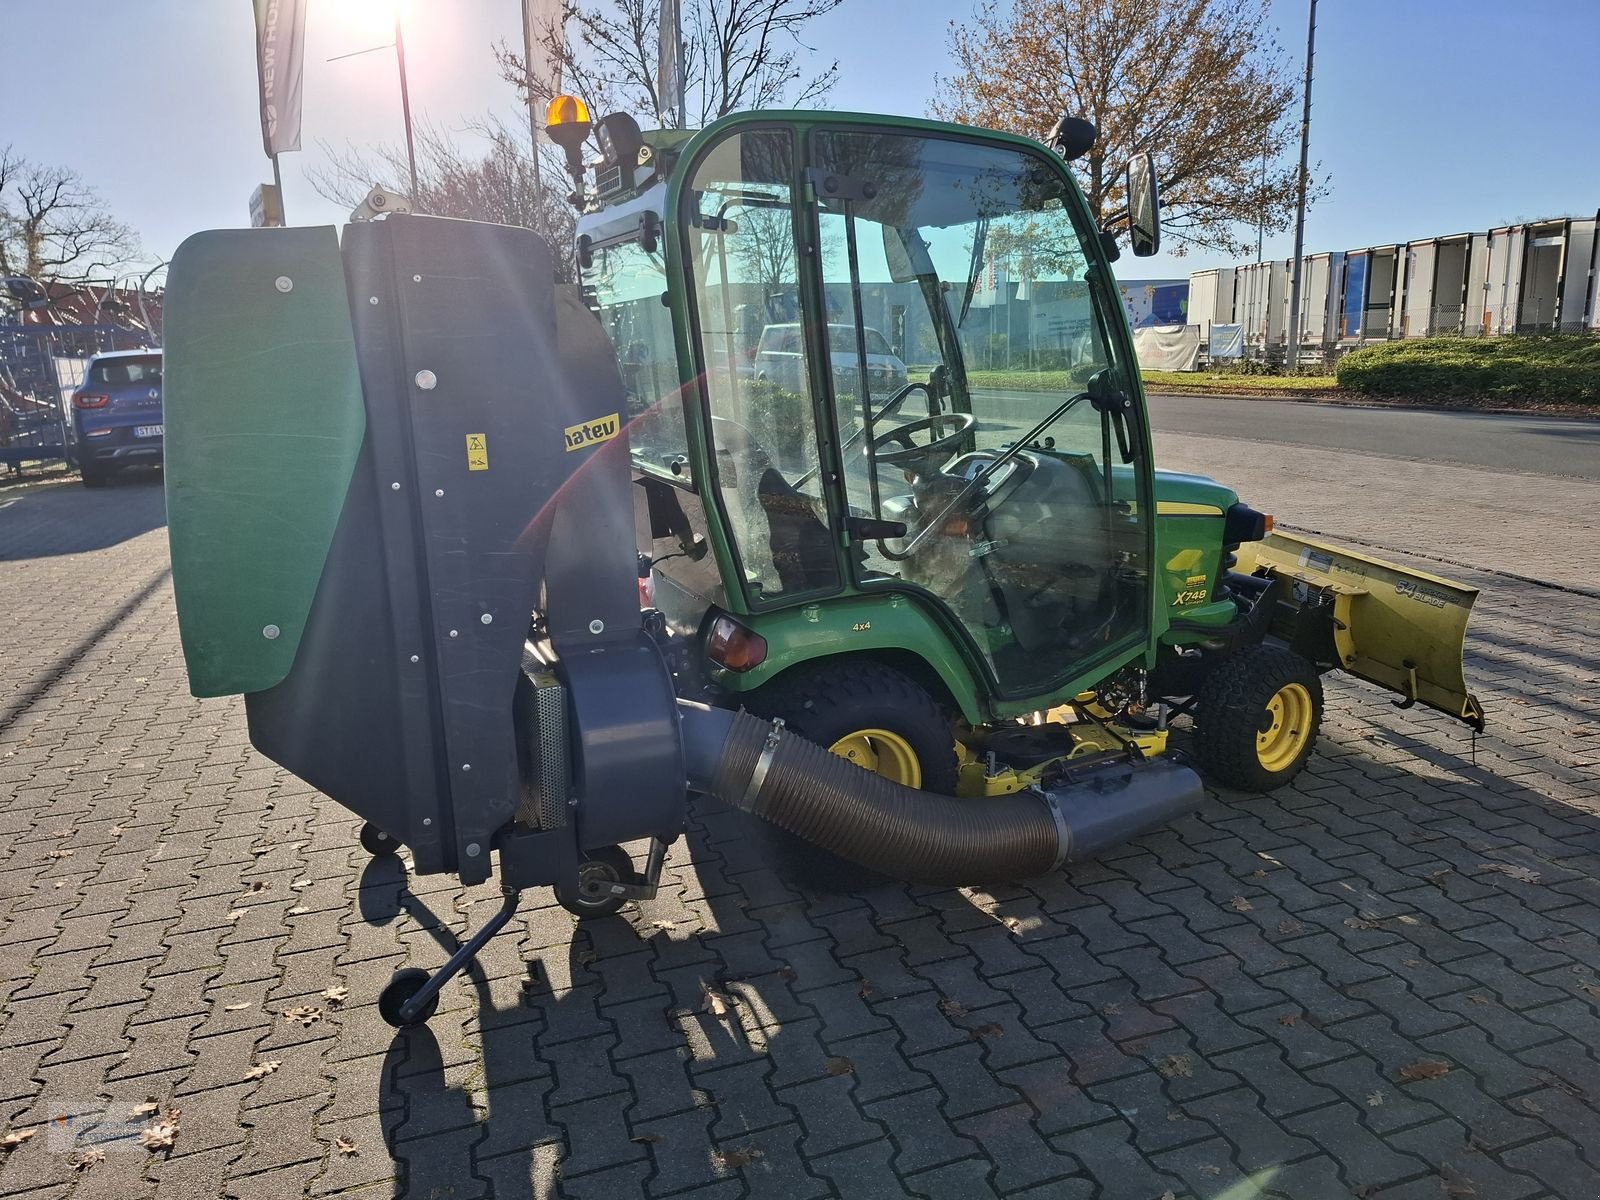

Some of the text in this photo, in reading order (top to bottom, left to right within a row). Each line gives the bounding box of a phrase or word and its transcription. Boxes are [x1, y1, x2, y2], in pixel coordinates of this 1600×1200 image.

[264, 47, 275, 98] NEW
[1394, 579, 1417, 598] 54
[1171, 589, 1207, 606] X748
[1414, 591, 1446, 608] BLADE
[852, 621, 871, 631] 4x4
